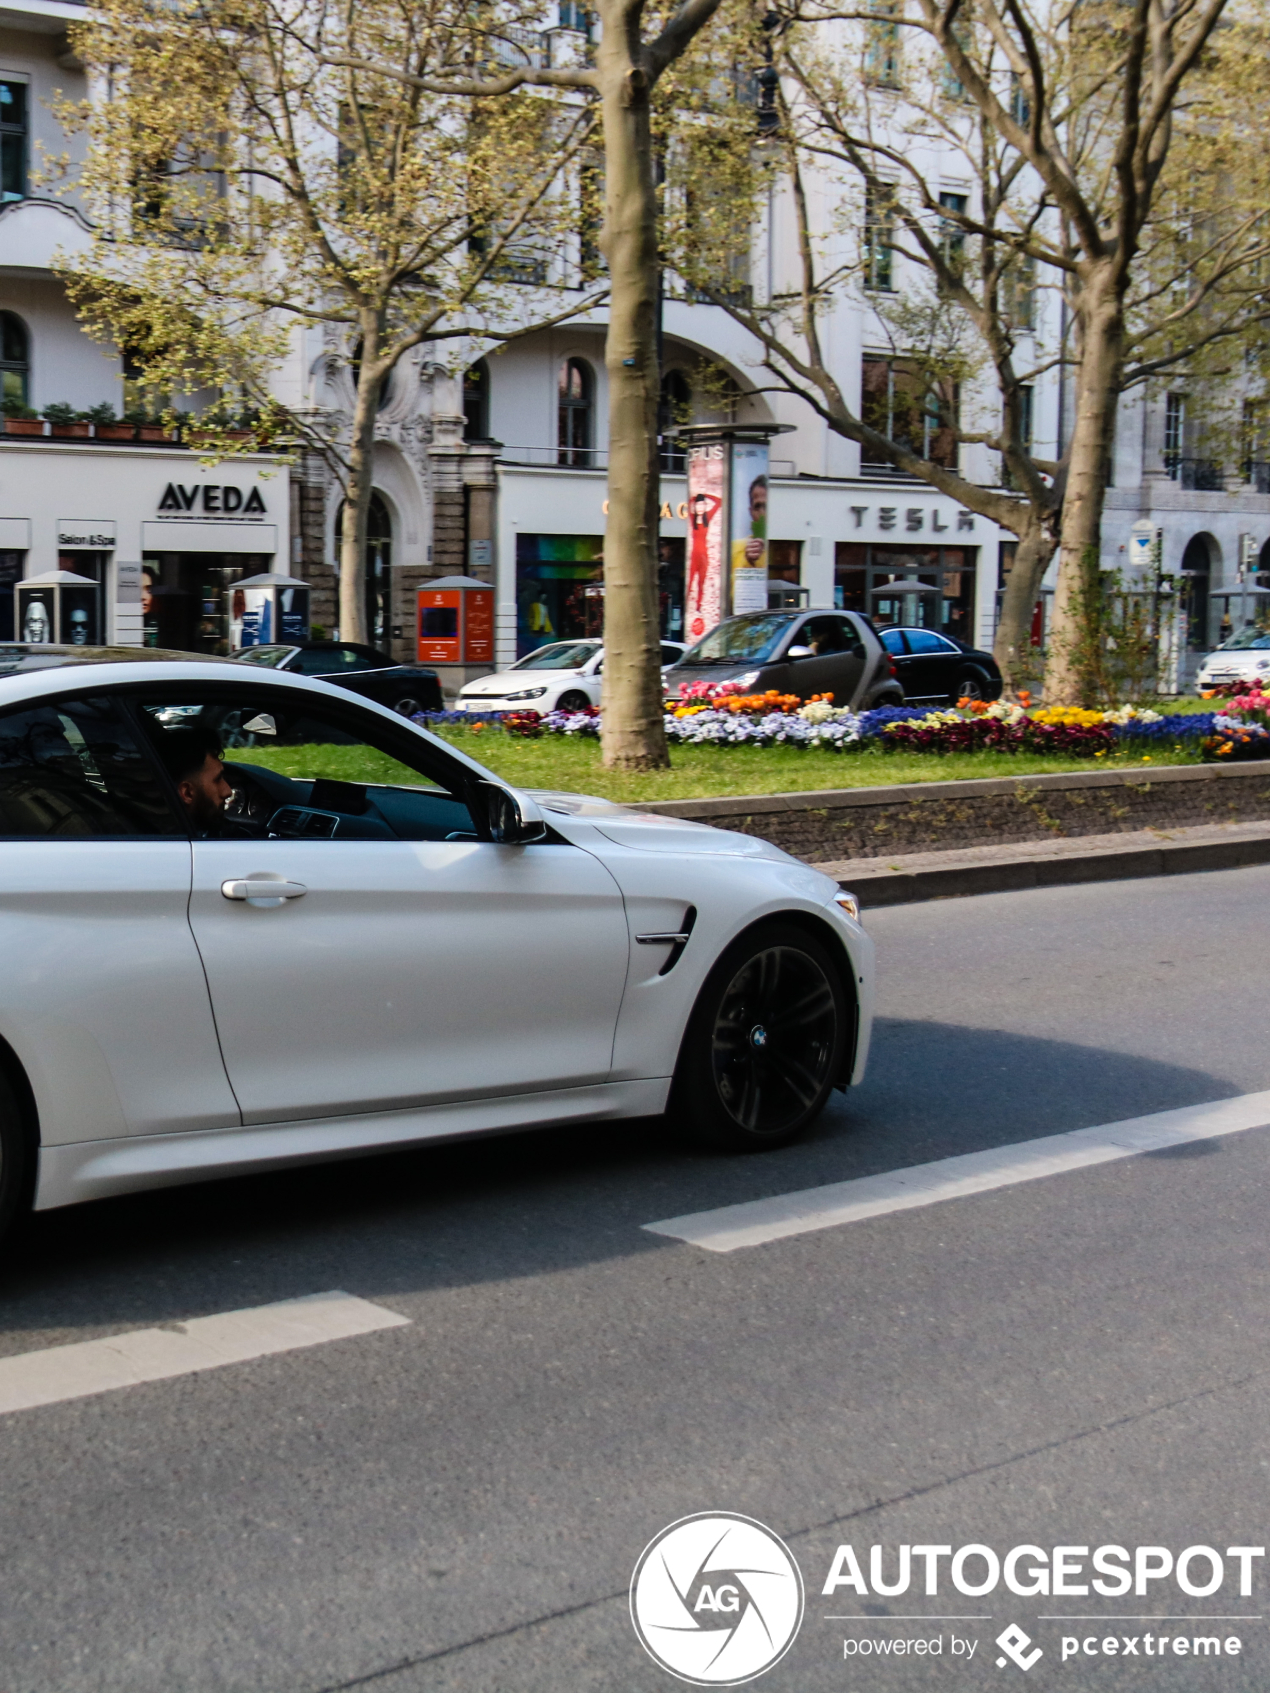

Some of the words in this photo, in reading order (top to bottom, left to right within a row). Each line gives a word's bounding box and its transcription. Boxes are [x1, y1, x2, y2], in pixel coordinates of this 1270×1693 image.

[158, 482, 267, 514] AVEDA
[849, 505, 975, 532] TESLA
[58, 533, 86, 545] Salon
